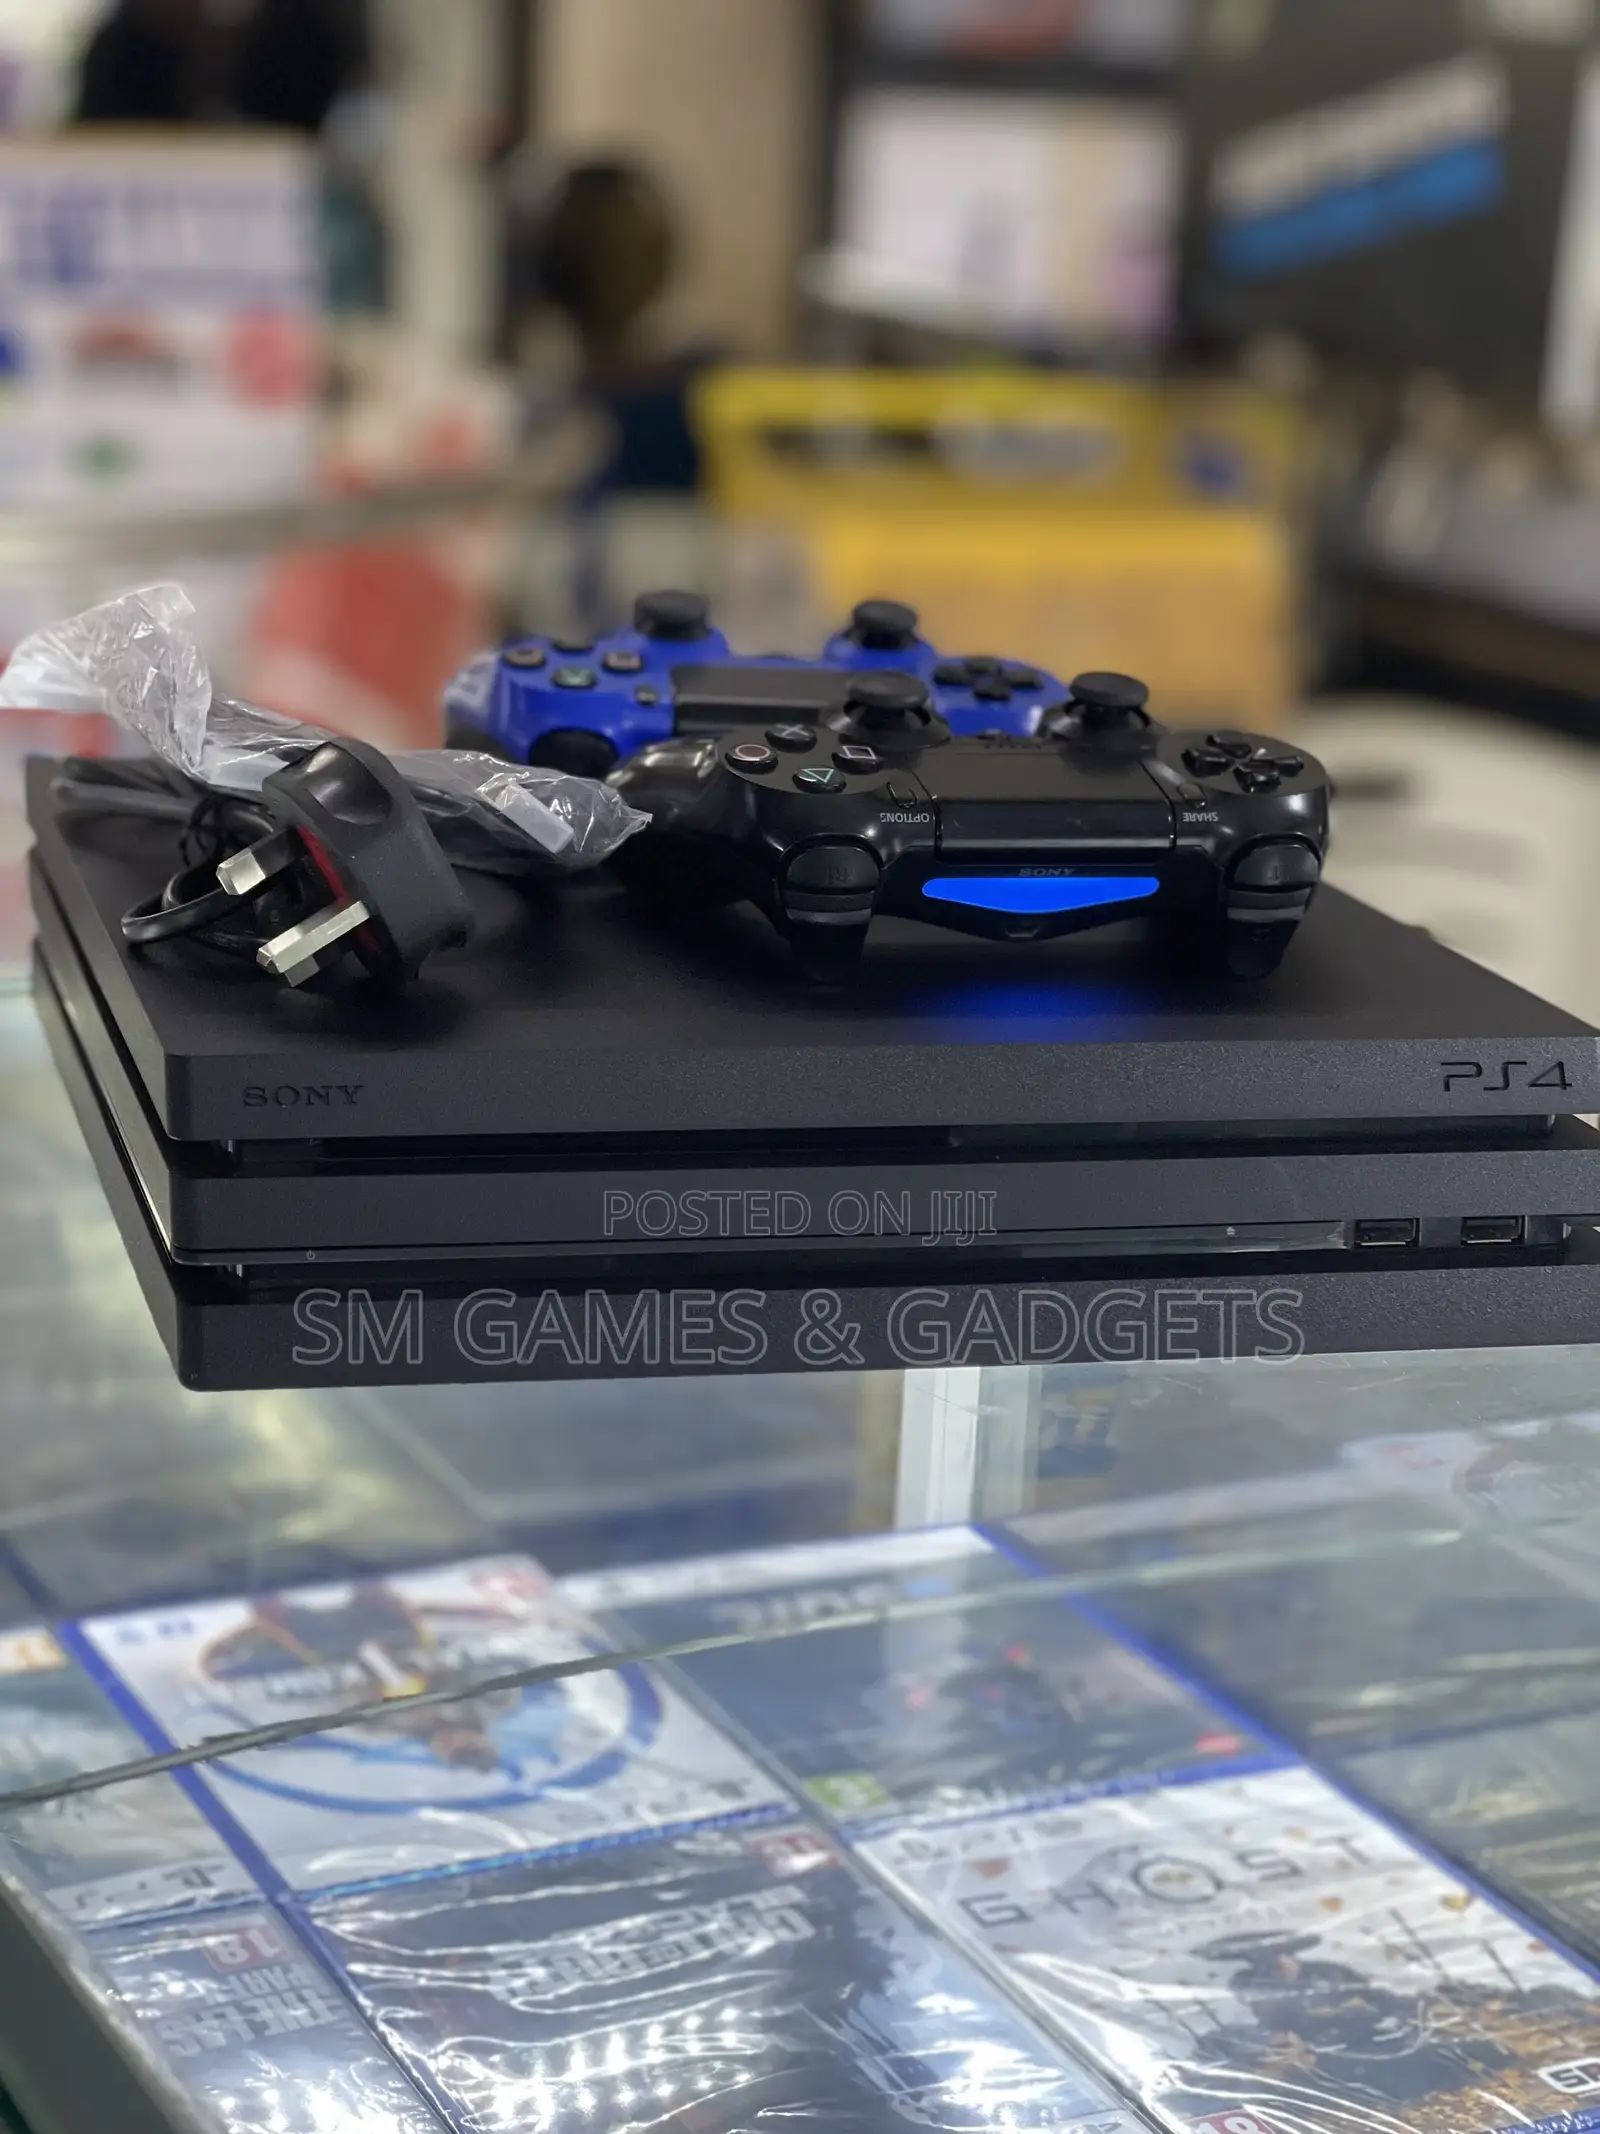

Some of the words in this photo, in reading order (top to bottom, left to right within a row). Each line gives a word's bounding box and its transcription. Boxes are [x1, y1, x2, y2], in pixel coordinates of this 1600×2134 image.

[879, 812, 930, 823] OPTIONS
[1182, 811, 1219, 822] SHARE
[1019, 867, 1076, 877] SONY
[1440, 1061, 1573, 1092] PS4
[243, 1085, 364, 1107] SONY
[956, 1833, 1376, 1929] GHOST
[208, 1929, 283, 1964] 18
[246, 1988, 338, 2036] THE
